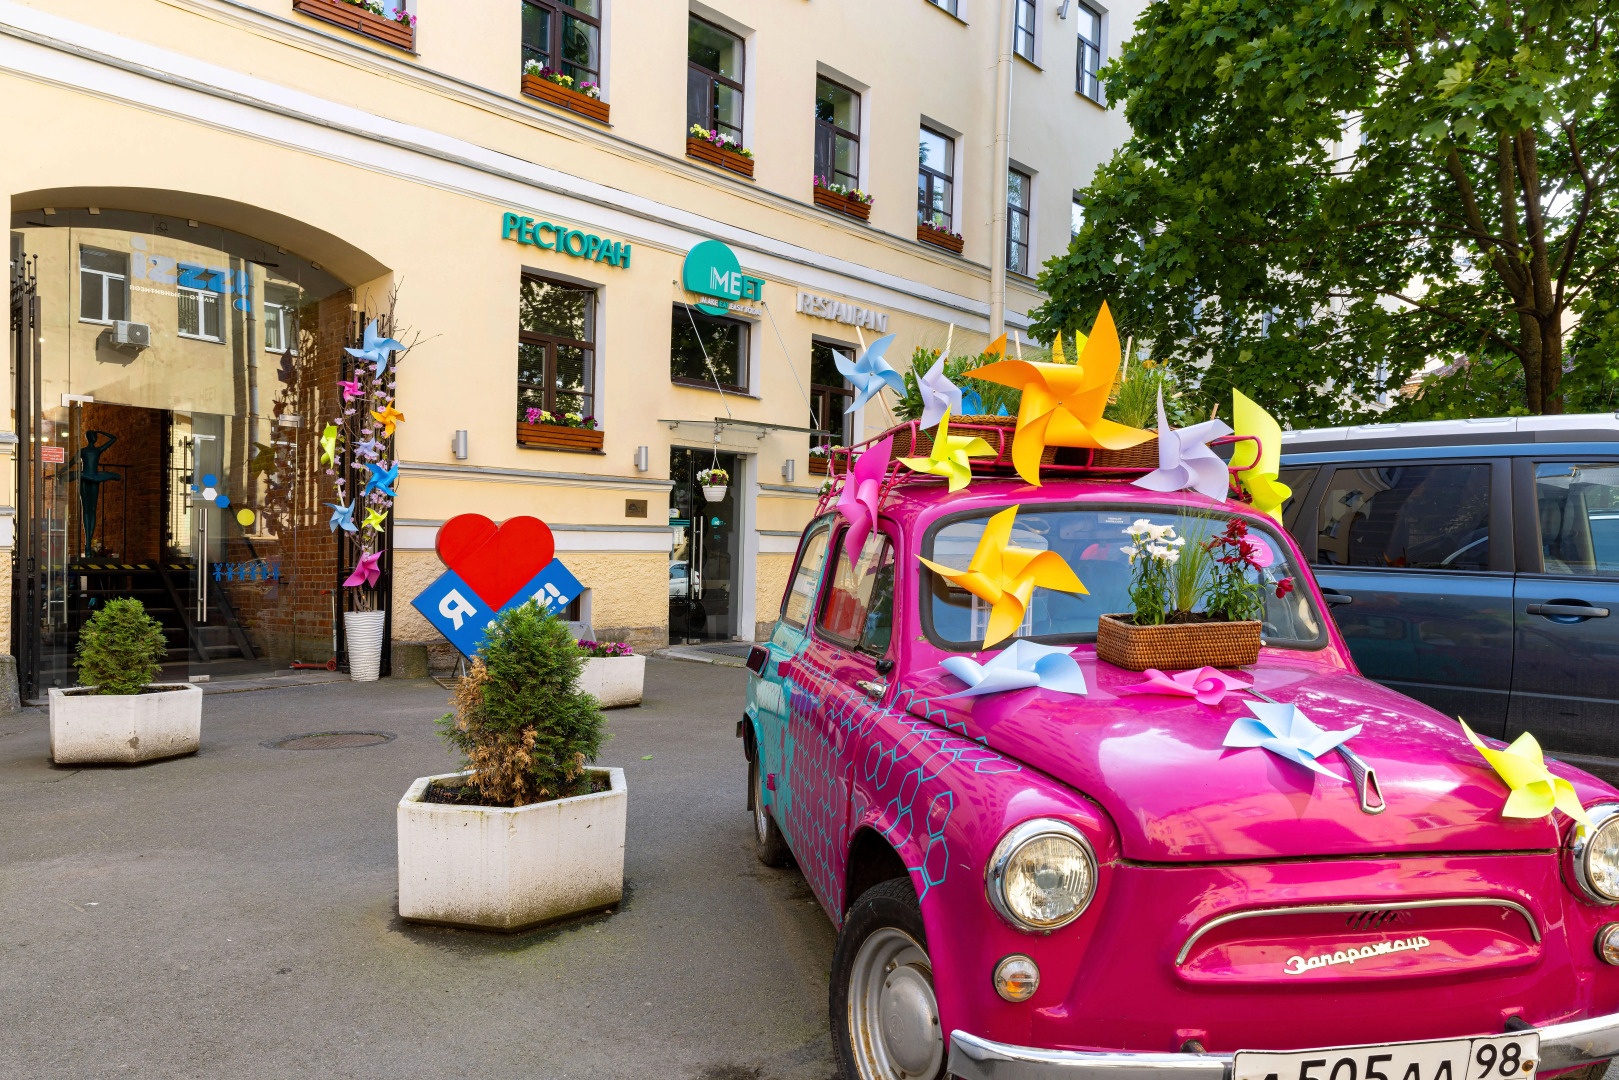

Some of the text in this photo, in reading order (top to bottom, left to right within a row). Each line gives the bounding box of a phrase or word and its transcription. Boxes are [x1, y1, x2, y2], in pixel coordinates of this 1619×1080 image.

[502, 212, 631, 268] РЕСТОРАН
[700, 296, 718, 307] MAKE
[718, 300, 730, 309] EAT
[710, 266, 765, 301] MEET
[796, 292, 890, 332] RESTAURANT
[438, 588, 477, 631] Я
[1476, 1042, 1521, 1079] 98
